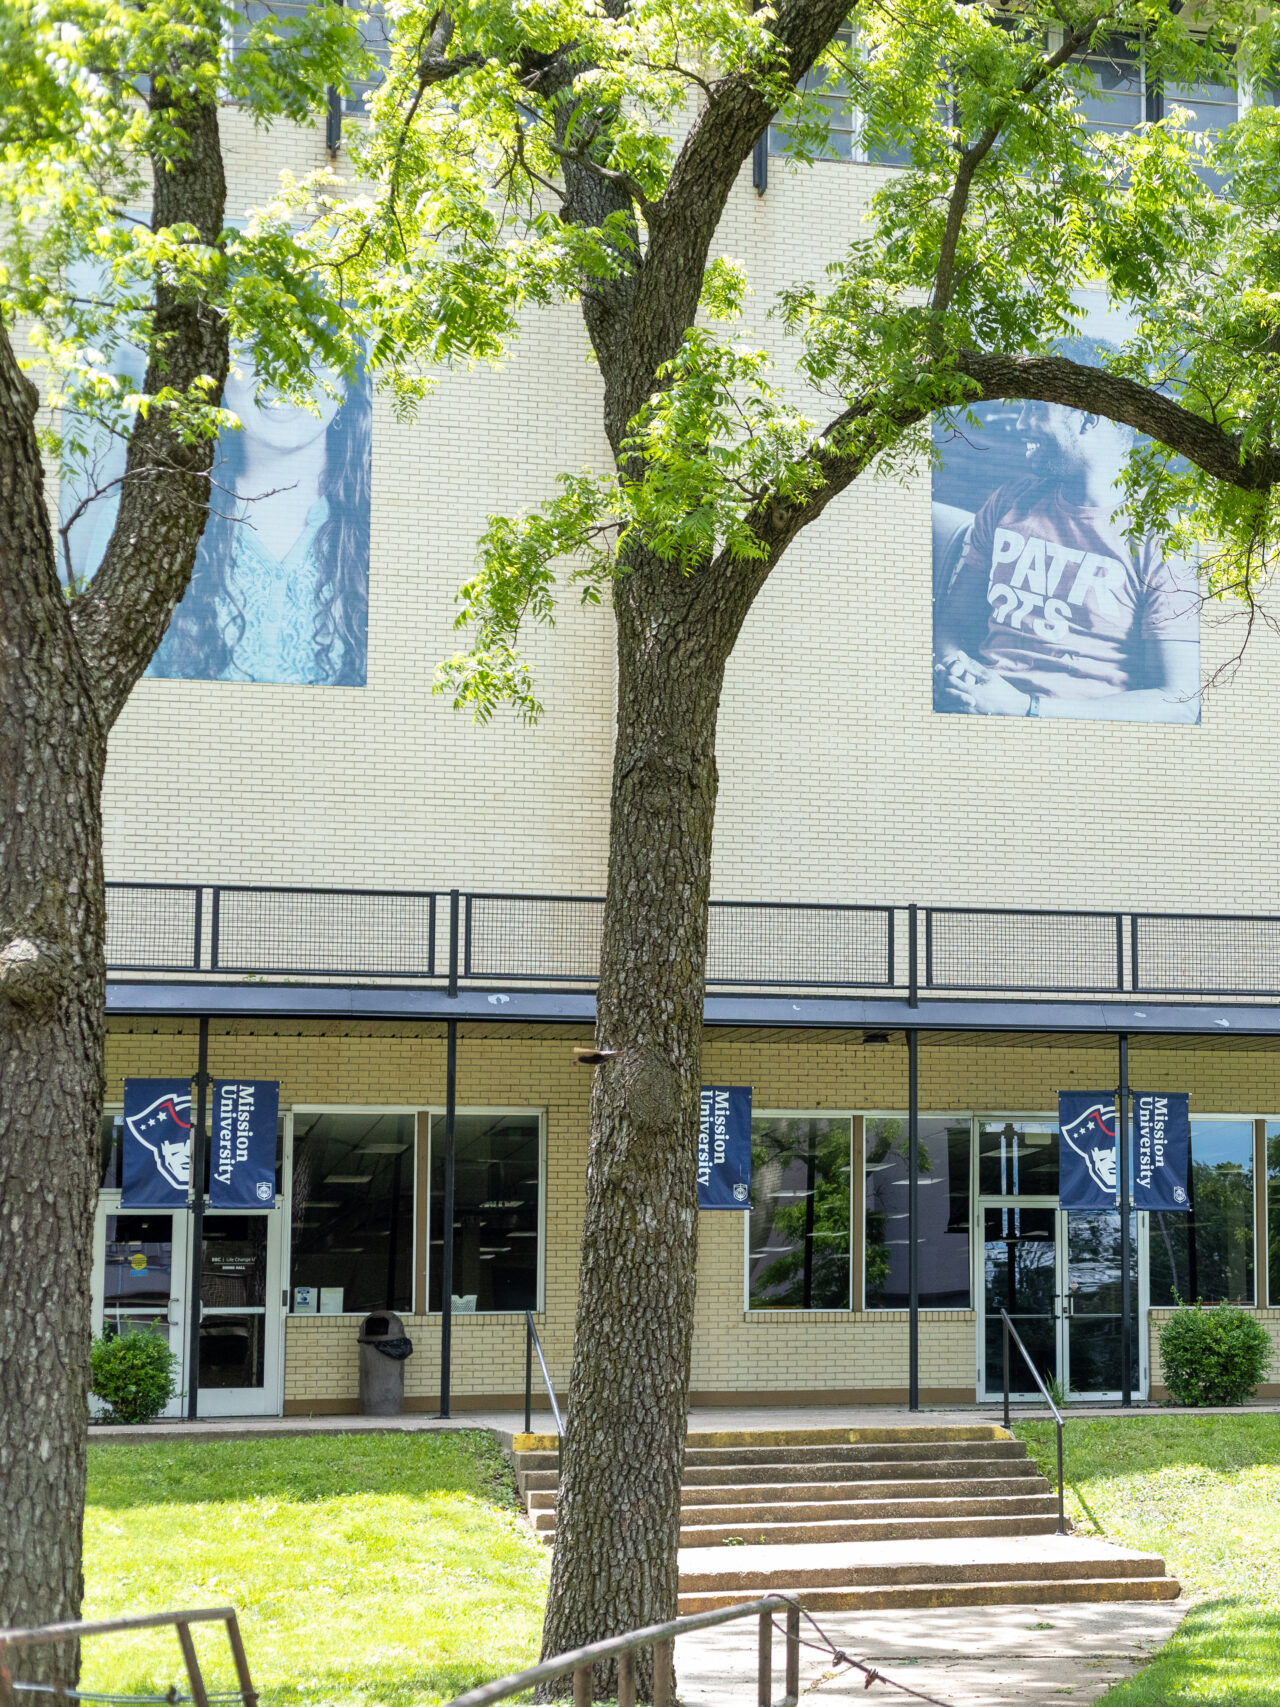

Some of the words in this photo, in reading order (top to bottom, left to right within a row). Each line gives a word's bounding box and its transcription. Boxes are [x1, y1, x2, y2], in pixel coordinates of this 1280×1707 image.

[213, 1084, 238, 1185] University
[236, 1085, 255, 1162] Mission
[696, 1090, 714, 1187] University
[713, 1090, 730, 1165] Mission
[1136, 1096, 1155, 1189] University
[1153, 1097, 1168, 1167] Mission
